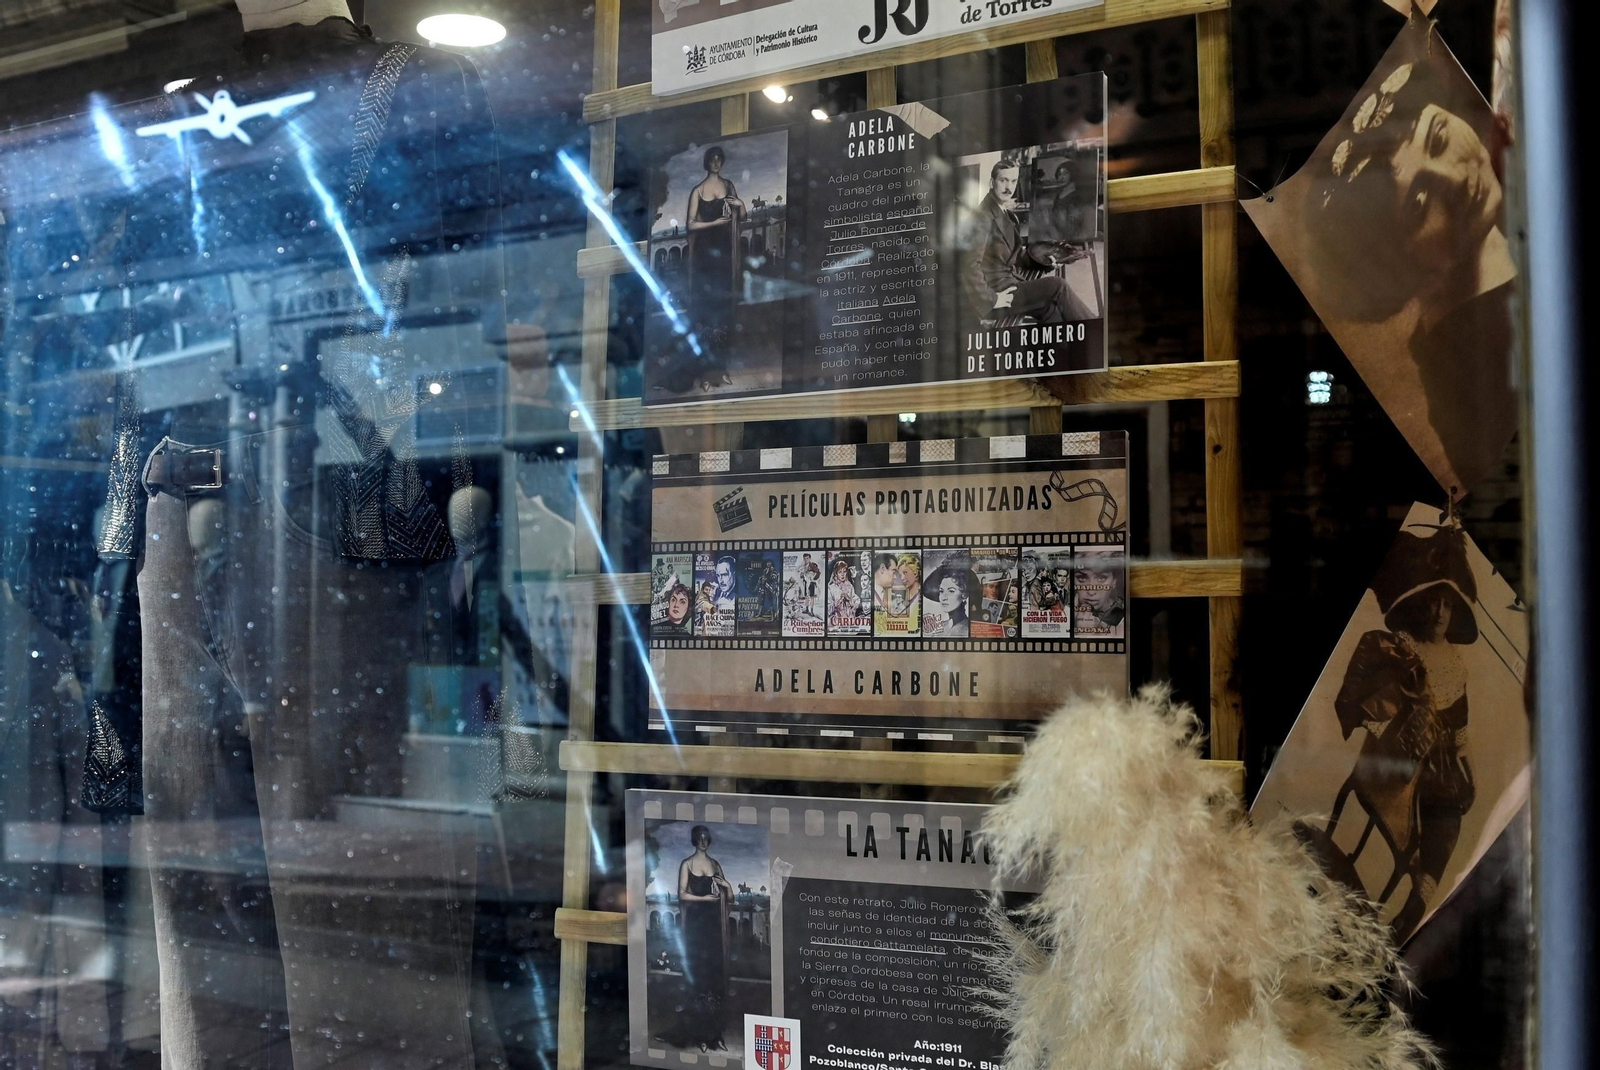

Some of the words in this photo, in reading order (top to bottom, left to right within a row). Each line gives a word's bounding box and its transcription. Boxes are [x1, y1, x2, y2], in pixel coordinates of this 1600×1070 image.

[960, 5, 982, 24] de
[985, 0, 1052, 18] Torres
[755, 30, 787, 44] Delegación
[787, 27, 796, 36] de
[797, 24, 818, 35] Cultura
[709, 36, 753, 55] AYUNTAMIENTO
[755, 47, 760, 56] y
[760, 40, 791, 53] Patrimonio
[792, 35, 818, 46] Histórico
[709, 56, 717, 65] DE
[717, 49, 746, 63] CÓRDOBA
[848, 116, 894, 139] ADELA
[848, 132, 915, 159] CARBONE
[828, 172, 859, 185] Adela
[920, 162, 930, 171] la
[837, 184, 884, 197] Tanagra
[887, 182, 902, 190] es
[906, 178, 921, 187] un
[828, 200, 868, 213] cuadro
[872, 196, 890, 206] del
[893, 191, 929, 205] pintor
[824, 210, 883, 227] simbolista
[886, 203, 934, 219] español
[830, 226, 857, 240] Julio
[861, 222, 907, 236] Romero
[911, 220, 926, 230] de
[871, 237, 911, 249] nacido
[915, 235, 930, 244] en
[878, 248, 935, 263] Realizado
[816, 275, 831, 284] en
[835, 271, 857, 282] 1911,
[861, 263, 927, 279] representa
[931, 263, 939, 271] a
[820, 288, 829, 298] la
[833, 284, 866, 297] actriz
[870, 284, 877, 294] y
[881, 278, 935, 291] escritora
[837, 298, 879, 311] italiana
[882, 293, 916, 306] Adela
[831, 312, 884, 326] Carbone,
[889, 308, 921, 320] quien
[819, 327, 859, 340] estaba
[863, 322, 915, 336] afincada
[919, 322, 934, 331] en
[967, 330, 1011, 351] JULIO
[1020, 323, 1085, 346] ROMERO
[815, 343, 860, 356] España,
[864, 343, 871, 352] y
[875, 340, 897, 350] con
[901, 337, 911, 346] la
[915, 336, 939, 346] que
[822, 357, 850, 371] pudo
[854, 354, 888, 368] haber
[893, 351, 931, 363] tenido
[967, 355, 985, 373] DE
[994, 348, 1055, 371] TORRES
[834, 373, 848, 382] un
[852, 368, 907, 381] romance.
[768, 488, 866, 519] PELÍCULAS
[875, 484, 1053, 515] PROTAGONIZADAS
[830, 616, 872, 627] CARLOTA
[754, 668, 834, 694] ADELA
[854, 670, 979, 697] CARBONE
[846, 824, 878, 858] LA
[799, 892, 821, 902] Con
[824, 895, 849, 905] este
[853, 897, 896, 909] retrato,
[900, 899, 927, 911] Julio
[930, 902, 976, 914] Romero
[808, 907, 825, 917] las
[828, 908, 862, 920] señas
[866, 911, 879, 921] de
[883, 913, 937, 925] identidad
[941, 916, 955, 926] de
[959, 918, 969, 928] la
[807, 920, 840, 932] incluir
[842, 923, 872, 935] junto
[886, 927, 913, 938] ellos
[916, 929, 926, 939] el
[810, 935, 870, 949] condotiero
[799, 947, 831, 959] fondo
[834, 950, 849, 960] de
[852, 951, 861, 961] la
[865, 953, 940, 968] composición,
[944, 960, 959, 969] un
[802, 961, 811, 970] la
[815, 961, 848, 973] Sierra
[851, 964, 913, 979] Cordobesa
[917, 972, 938, 982] con
[942, 973, 953, 983] el
[800, 976, 807, 985] y
[810, 976, 857, 989] cipreses
[860, 980, 875, 990] de
[878, 981, 888, 991] la
[892, 983, 919, 993] casa
[923, 985, 938, 996] de
[811, 990, 824, 998] en
[828, 989, 879, 1003] Córdoba.
[882, 996, 898, 1005] Un
[902, 998, 930, 1009] rosal
[811, 1003, 847, 1014] enlaza
[851, 1005, 860, 1015] el
[864, 1007, 908, 1021] primero
[911, 1012, 933, 1023] con
[937, 1014, 954, 1025] los
[914, 1039, 962, 1053] Año:1911
[827, 1044, 885, 1059] Colección
[888, 1051, 932, 1064] privada
[936, 1056, 955, 1067] del
[958, 1058, 976, 1069] Dr.
